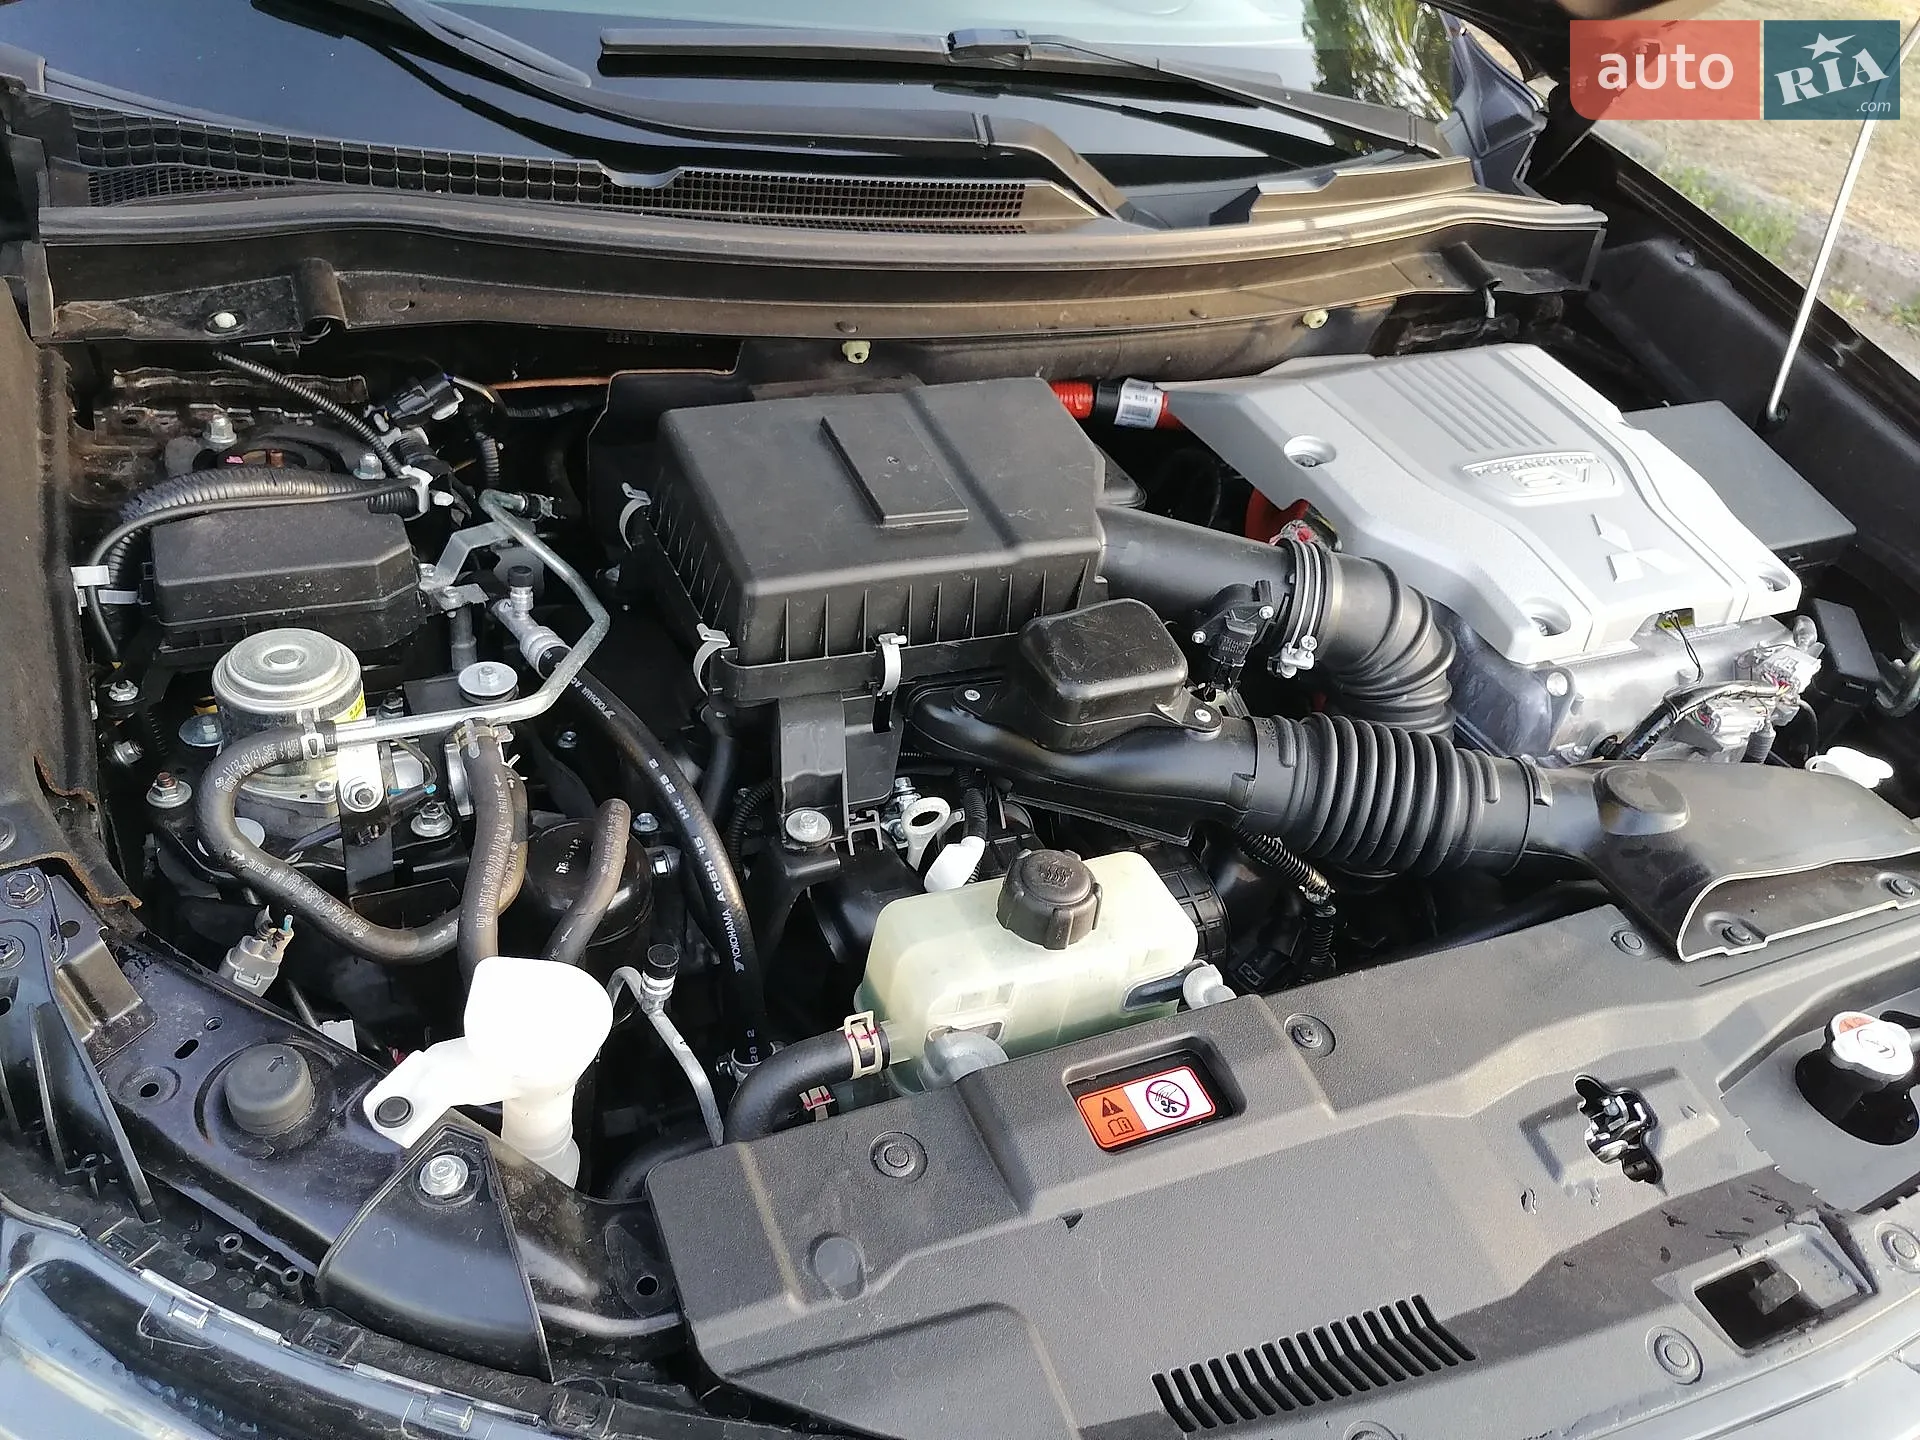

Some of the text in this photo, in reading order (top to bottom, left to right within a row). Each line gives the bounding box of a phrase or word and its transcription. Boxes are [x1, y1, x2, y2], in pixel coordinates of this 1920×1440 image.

[660, 775, 676, 793] 28
[673, 801, 690, 820] HK
[723, 909, 741, 959] YOKOHAMA
[746, 1029, 759, 1062] 28 2
